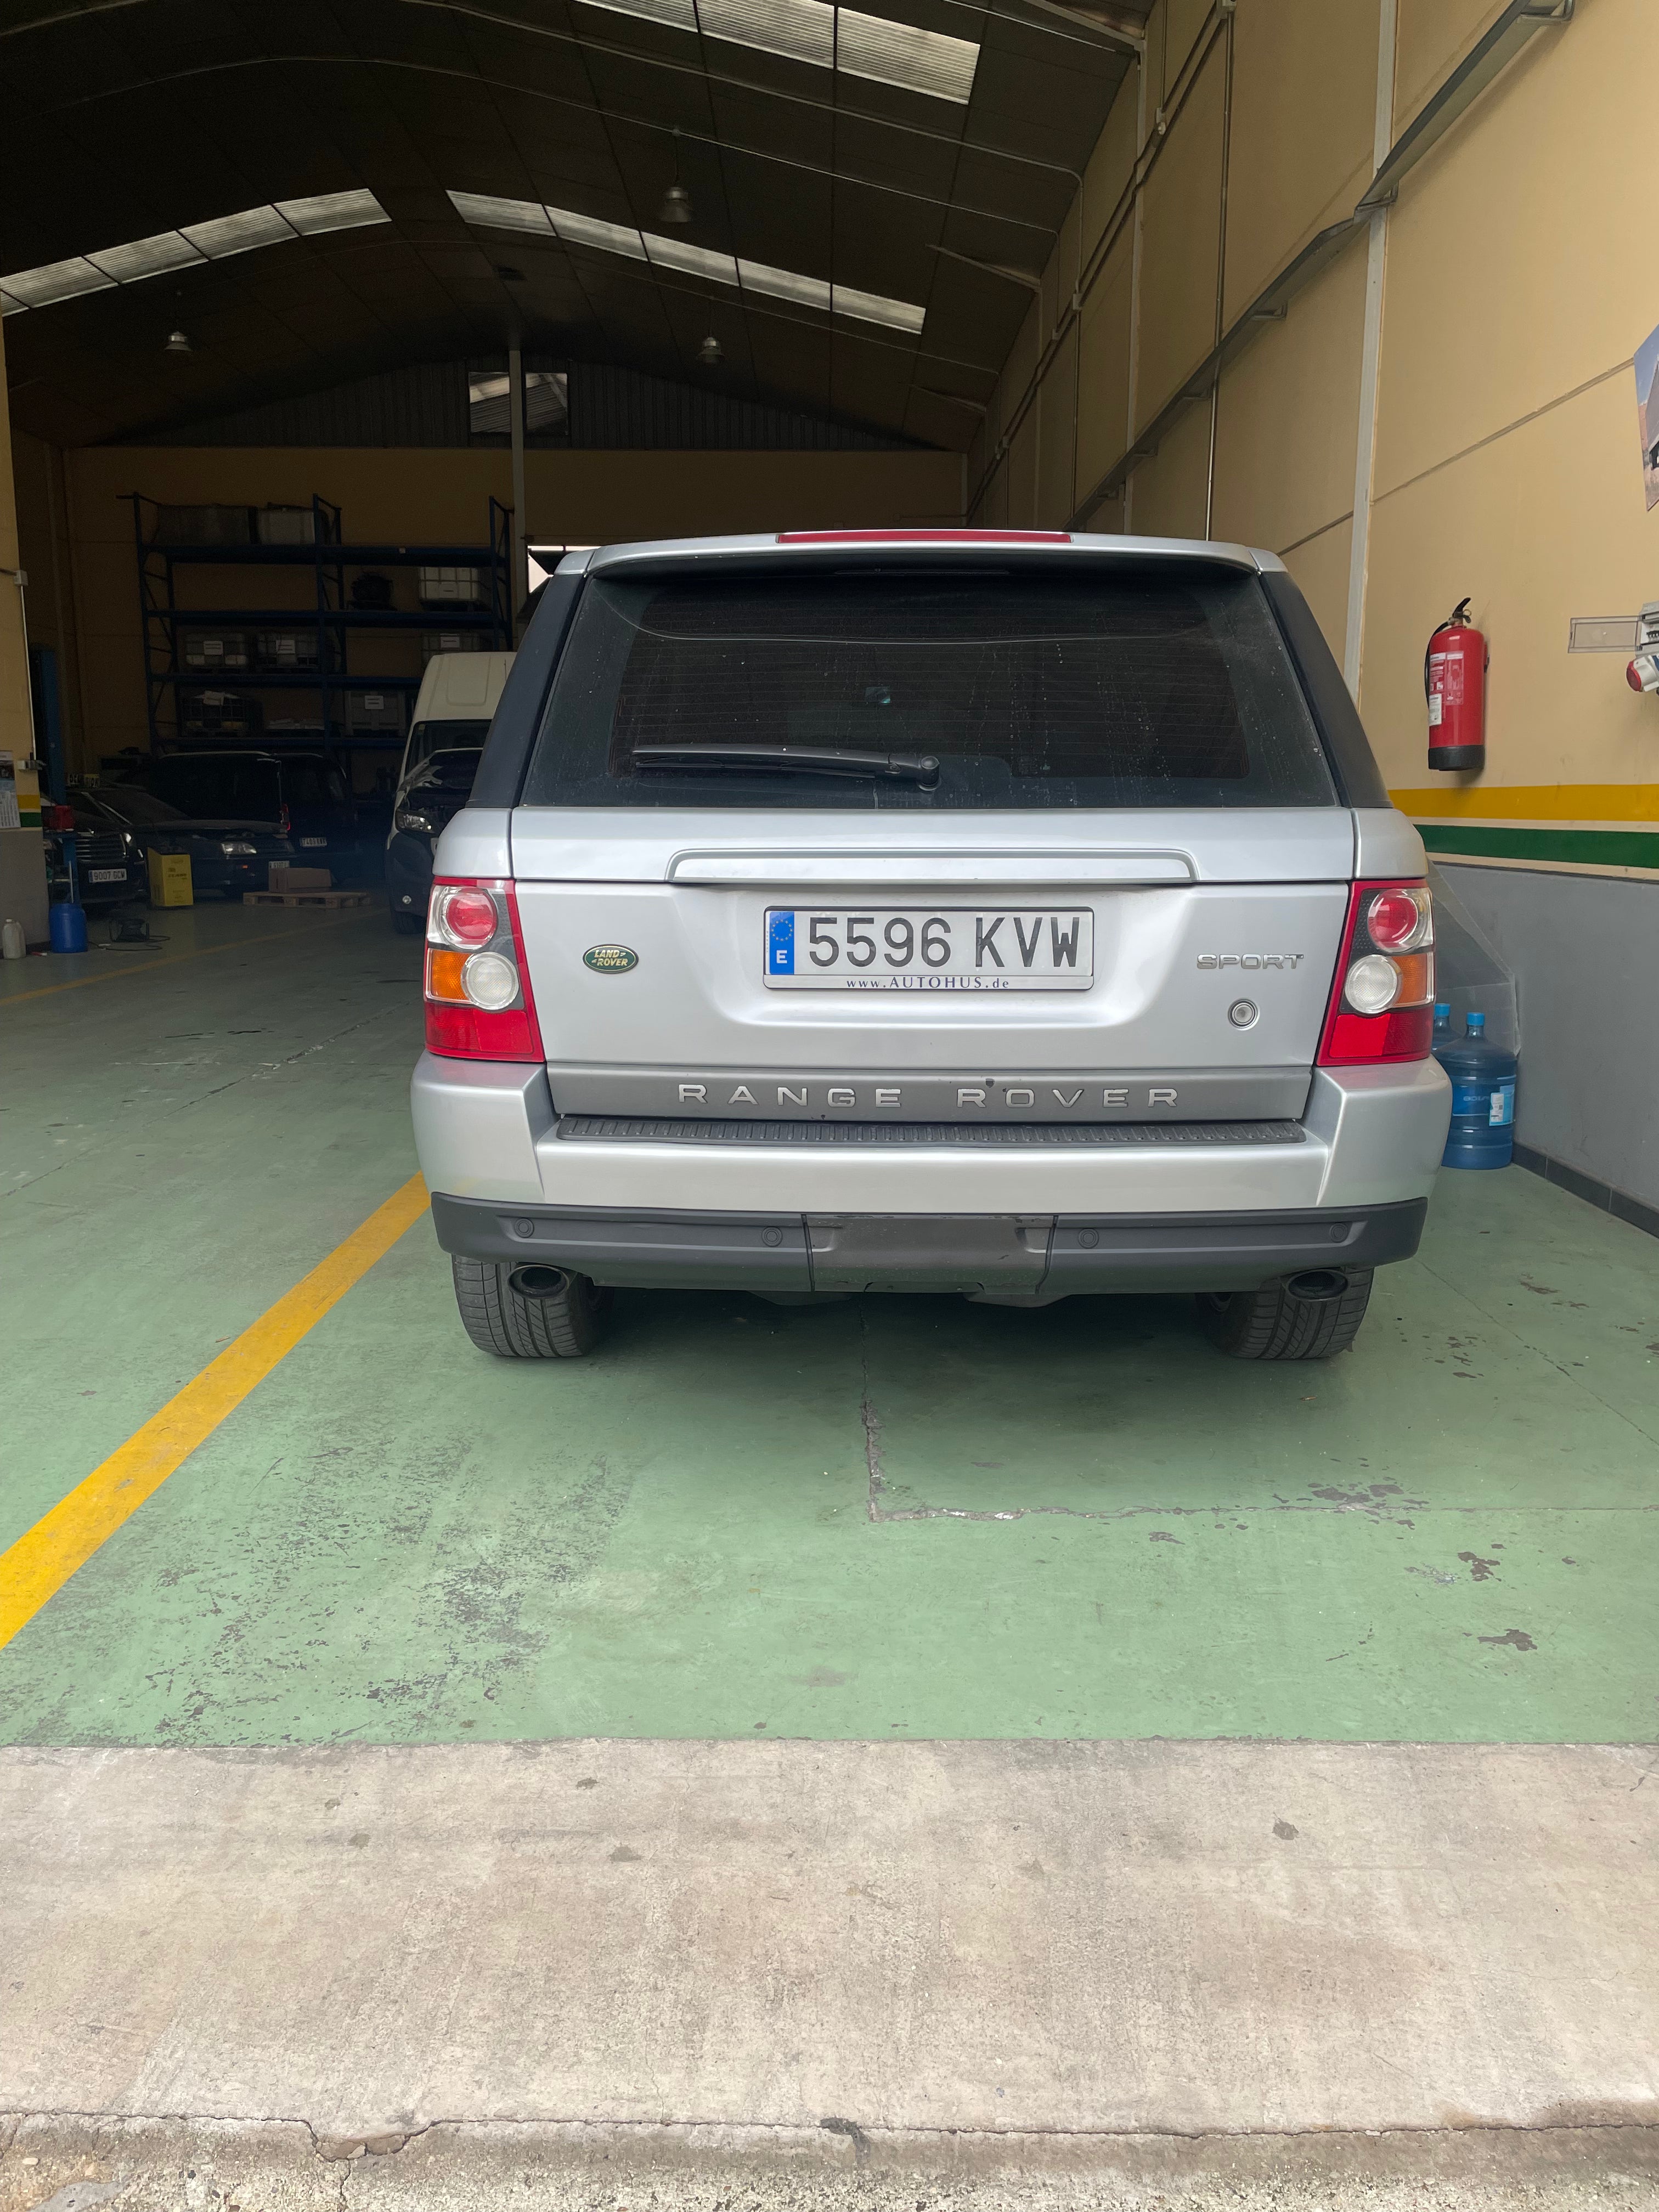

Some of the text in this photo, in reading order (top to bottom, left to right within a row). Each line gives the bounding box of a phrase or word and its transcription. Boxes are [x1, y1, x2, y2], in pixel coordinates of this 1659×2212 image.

[94, 871, 111, 881] 9007
[809, 917, 951, 967] 5596
[975, 917, 1080, 967] KVW
[594, 950, 620, 958] LAND
[776, 950, 787, 964] E
[1197, 954, 1304, 969] SPORT
[847, 977, 1009, 989] www.AUTOHUS.de
[678, 1084, 1178, 1108] RANGE ROVER
